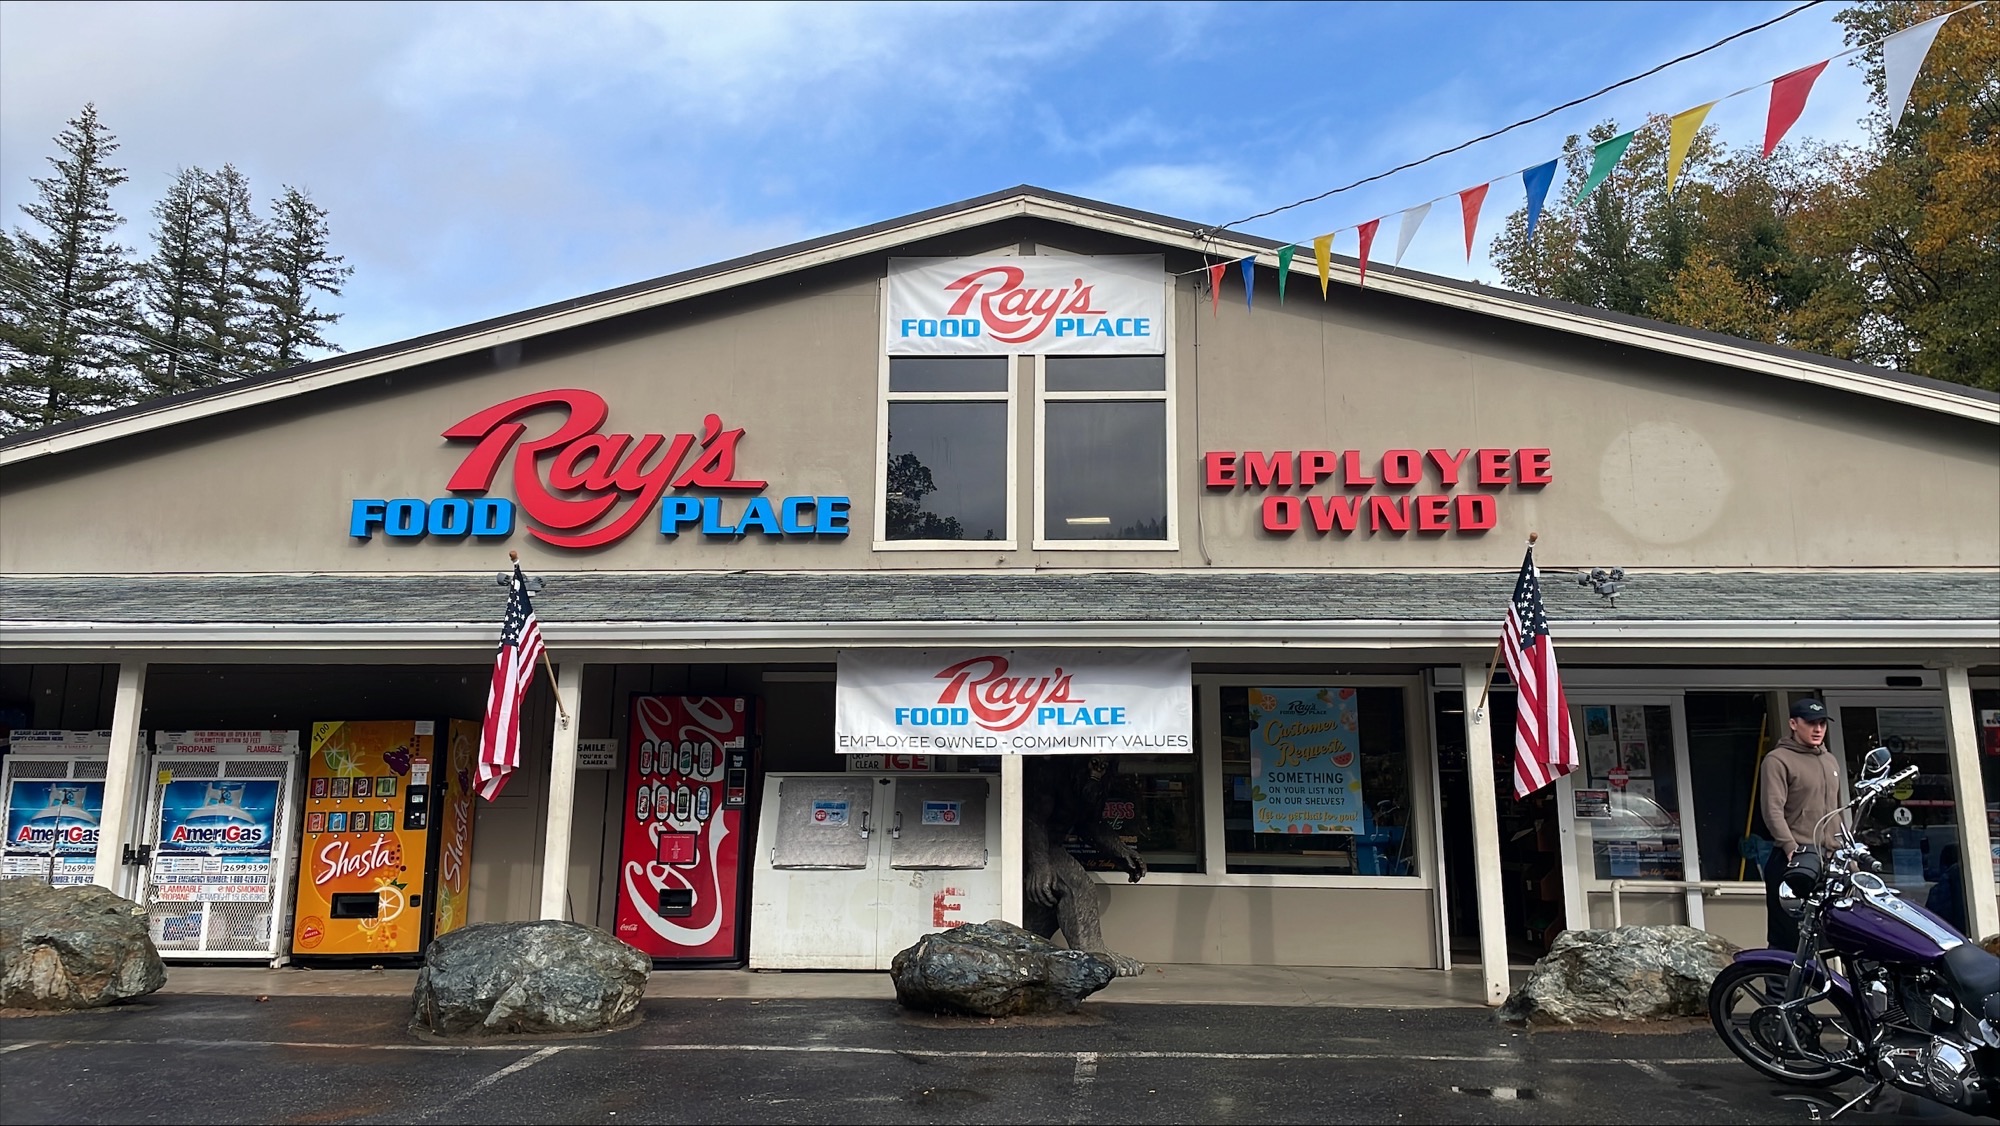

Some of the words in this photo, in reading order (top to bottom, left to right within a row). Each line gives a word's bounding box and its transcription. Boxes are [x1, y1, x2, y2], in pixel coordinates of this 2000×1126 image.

[944, 266, 1107, 343] Ray's
[901, 319, 981, 338] FOOD
[1055, 318, 1151, 337] PLACE
[441, 389, 769, 549] Ray's
[1205, 448, 1552, 488] EMPLOYEE
[349, 497, 516, 540] FOOD
[660, 496, 851, 538] PLACE
[1262, 494, 1497, 533] OWNED
[933, 655, 1086, 731] Ray's
[895, 707, 968, 726] FOOD
[1037, 707, 1126, 726] PLACE
[1288, 700, 1317, 716] Ray's
[839, 735, 930, 748] EMPLOYEE
[934, 736, 998, 748] OWNED
[1012, 735, 1118, 749] COMMUNITY
[1120, 734, 1189, 748] VALUES
[1264, 719, 1339, 746] Customer
[176, 745, 216, 753] PROPANE
[246, 745, 283, 753] FLAMMABLE
[578, 743, 606, 752] SMILE
[1275, 739, 1346, 767] Requests
[855, 760, 879, 769] CLEAR
[1268, 772, 1344, 784] SOMETHING
[1268, 786, 1281, 794] ON
[1308, 787, 1325, 795] LIST
[1328, 787, 1344, 795] NOT
[1268, 797, 1281, 805] ON
[1284, 797, 1302, 805] OUR
[1305, 797, 1345, 806] SHELVES?
[172, 825, 262, 842] AmeriGas
[444, 800, 470, 893] Shasta
[316, 838, 397, 885] Shasta
